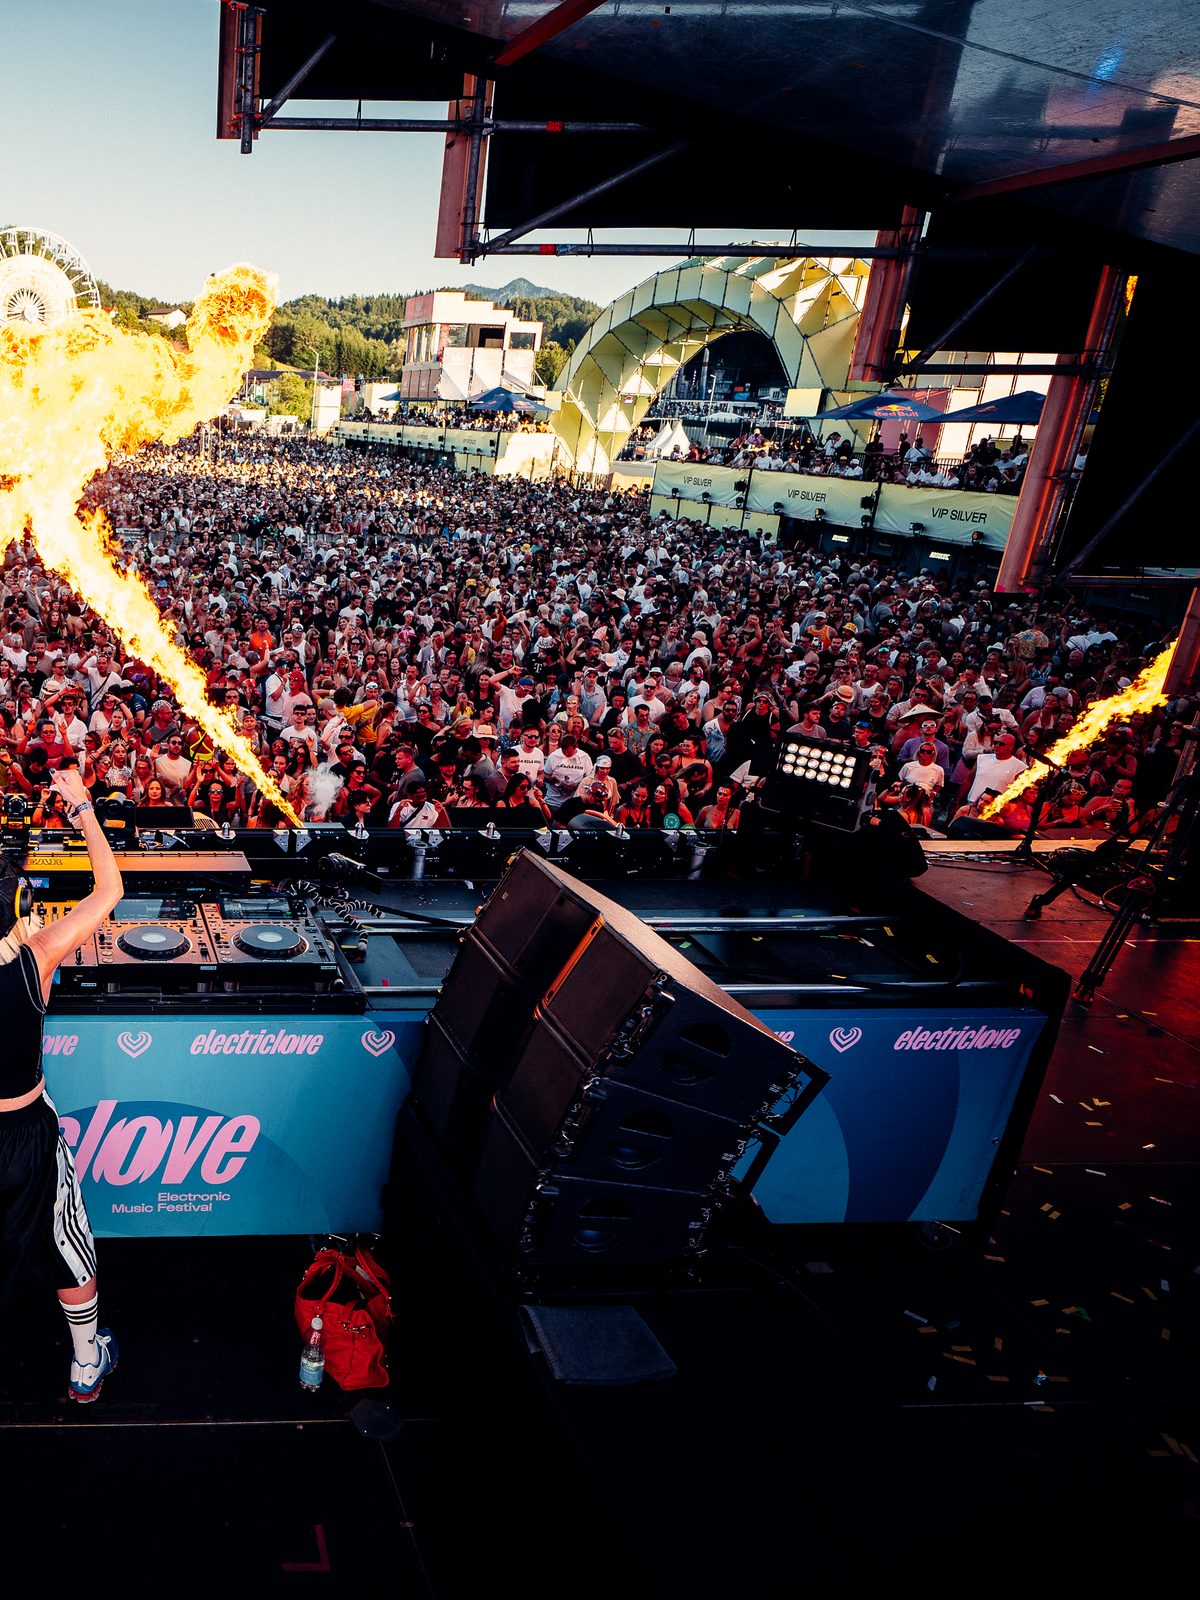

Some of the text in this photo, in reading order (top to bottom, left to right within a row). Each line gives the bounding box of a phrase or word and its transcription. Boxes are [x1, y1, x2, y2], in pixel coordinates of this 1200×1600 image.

[683, 476, 713, 488] VIP SILVER
[787, 489, 827, 503] VIP SILVER
[931, 507, 988, 525] VIP SILVER
[189, 1029, 324, 1055] electriclove
[893, 1025, 1021, 1051] electriclove
[157, 1192, 231, 1202] Electronic
[112, 1202, 213, 1214] Music Festival
